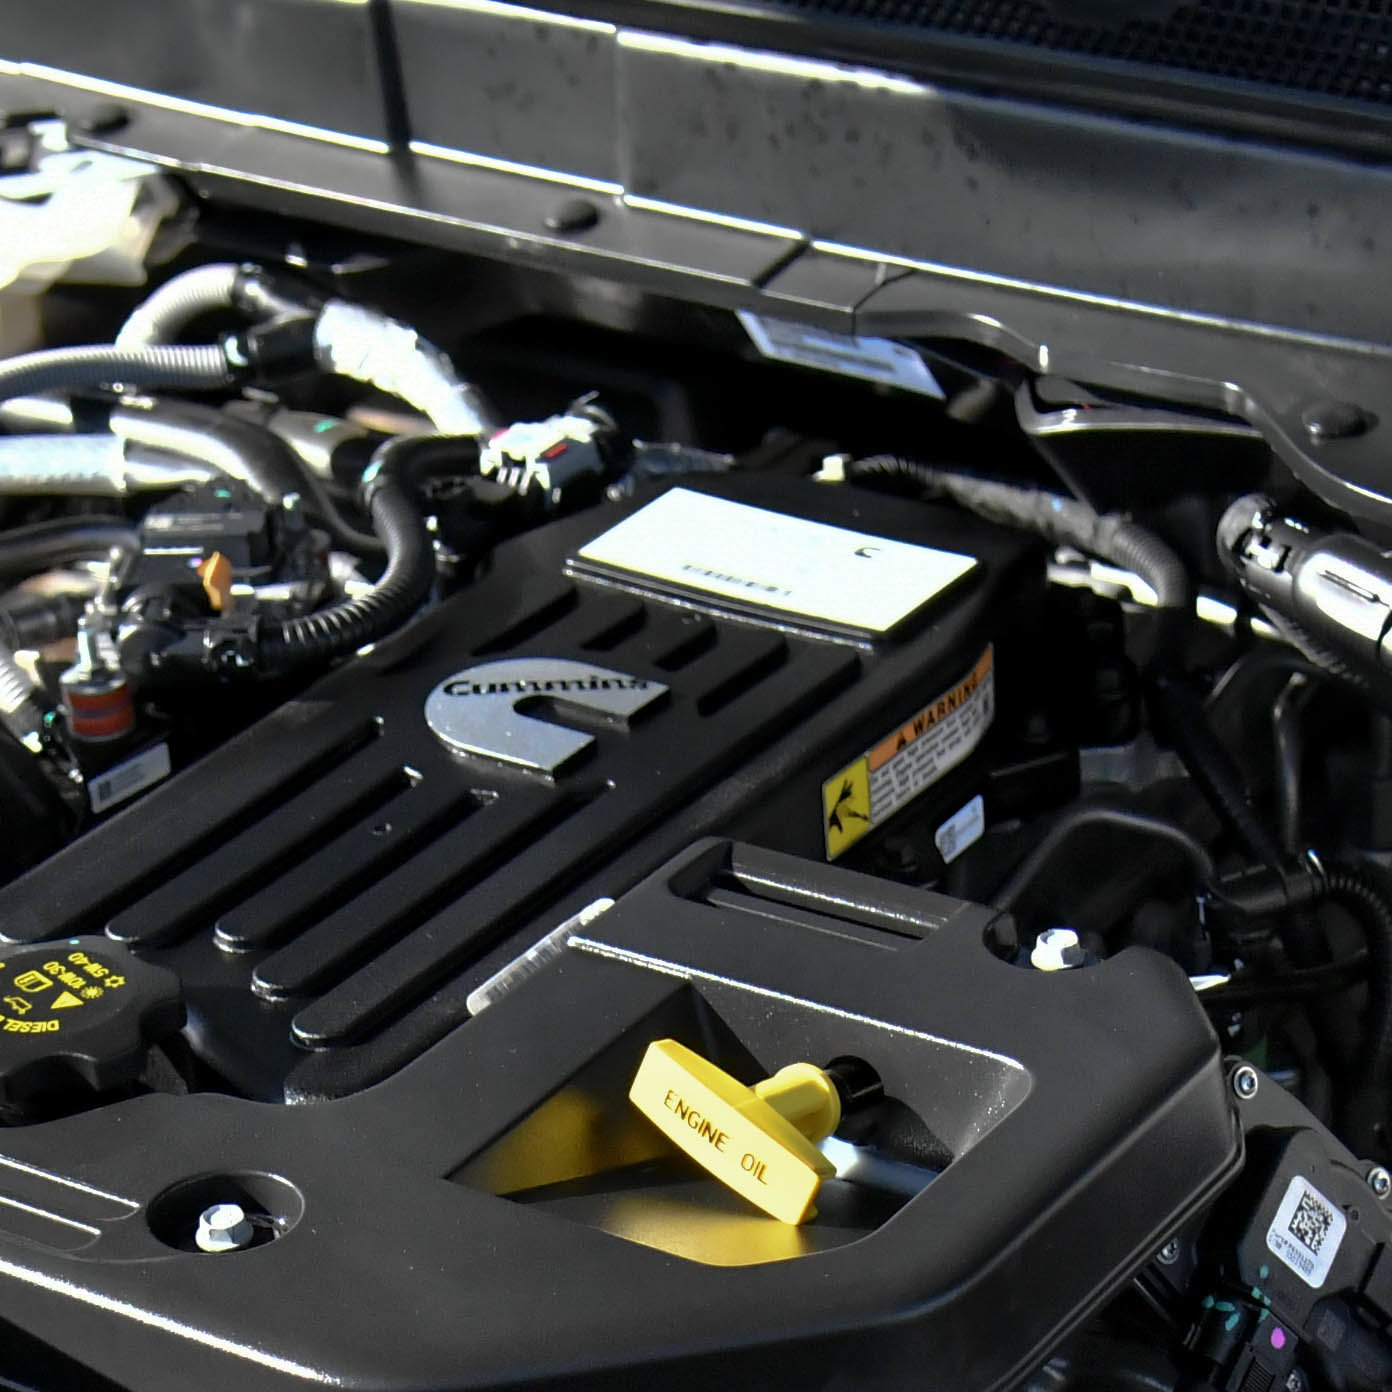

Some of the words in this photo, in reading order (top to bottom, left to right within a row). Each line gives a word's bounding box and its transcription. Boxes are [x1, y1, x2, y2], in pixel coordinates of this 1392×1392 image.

[444, 674, 650, 696] Cummins
[912, 671, 978, 737] WARNING
[43, 960, 88, 990] 10W-30
[68, 952, 110, 979] 5W-40
[4, 1018, 60, 1033] DIESEL
[663, 1089, 730, 1153] ENGINE
[740, 1152, 768, 1185] OIL
